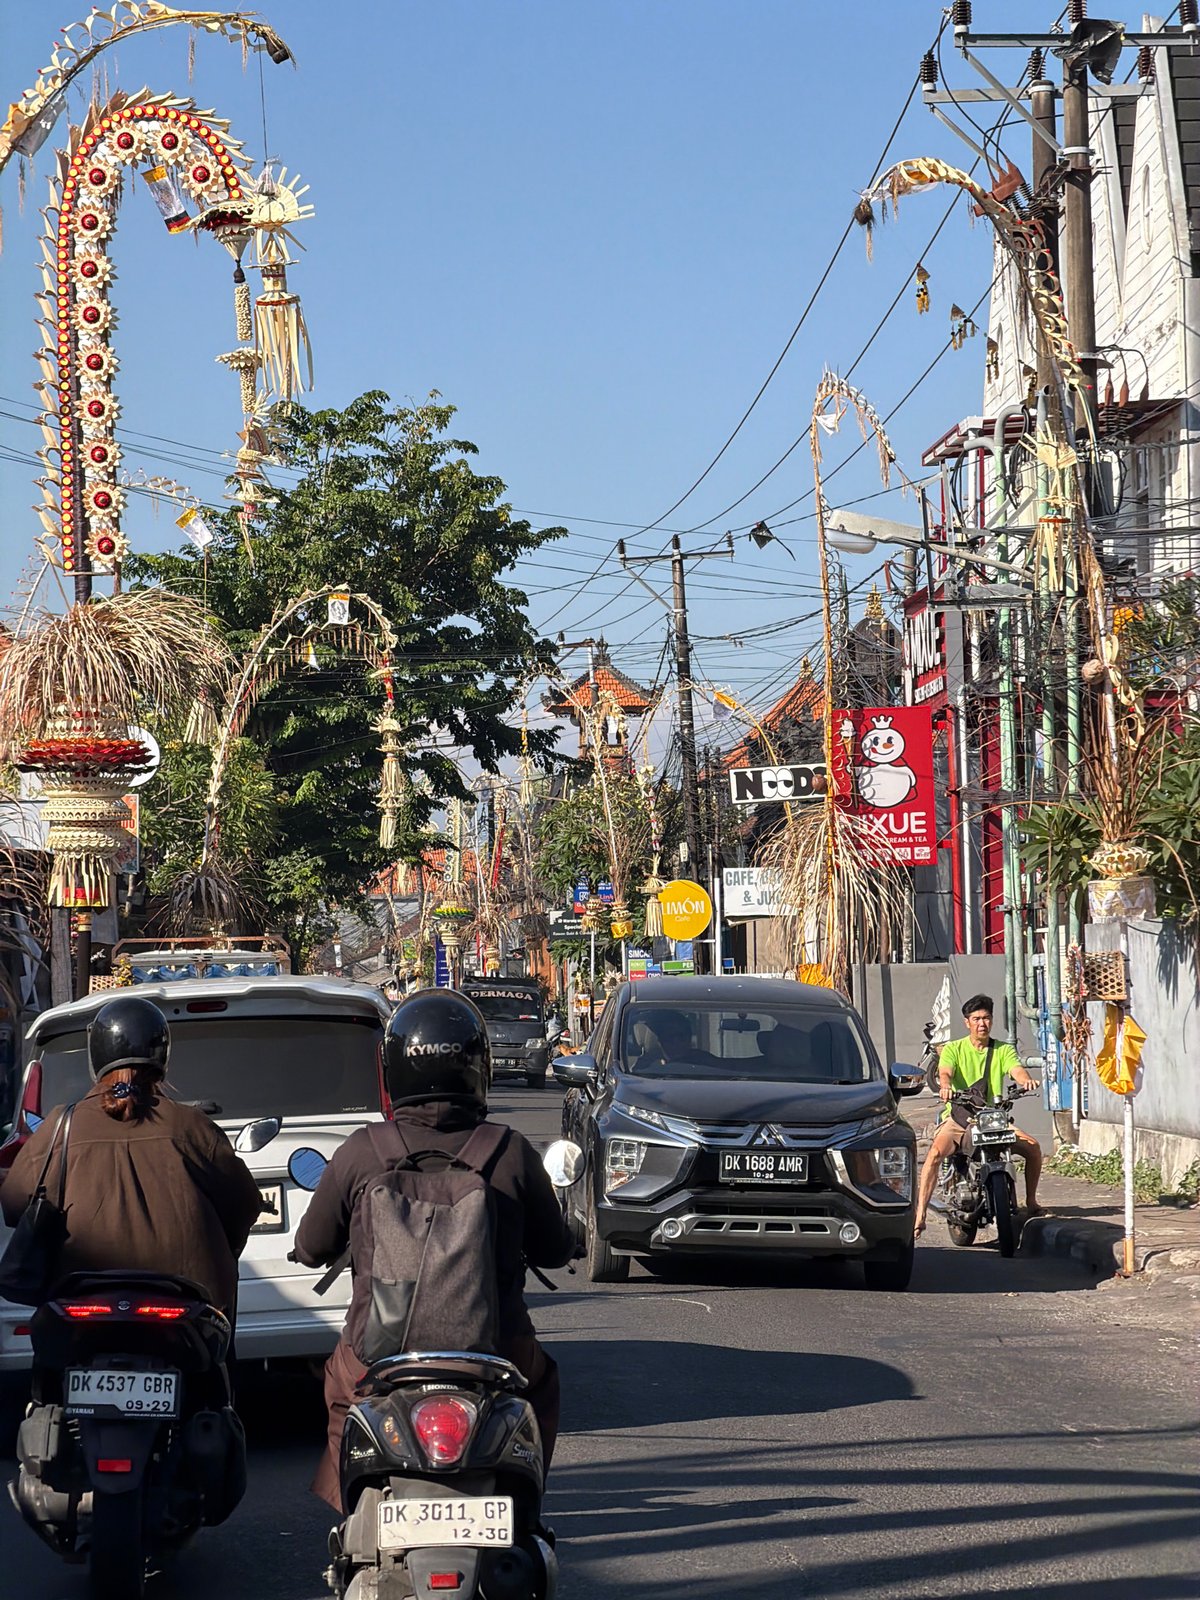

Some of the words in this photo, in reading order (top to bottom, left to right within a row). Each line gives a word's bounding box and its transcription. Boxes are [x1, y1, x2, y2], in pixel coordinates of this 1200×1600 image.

[743, 890, 752, 903] &
[406, 1043, 462, 1058] KYMCO
[725, 1155, 741, 1171] DK
[745, 1155, 775, 1171] 1688
[778, 1156, 803, 1173] AMR
[71, 1375, 92, 1393] DK
[96, 1375, 136, 1392] 4537
[143, 1376, 173, 1395] GBR
[383, 1504, 407, 1524] DK
[484, 1501, 508, 1520] GP
